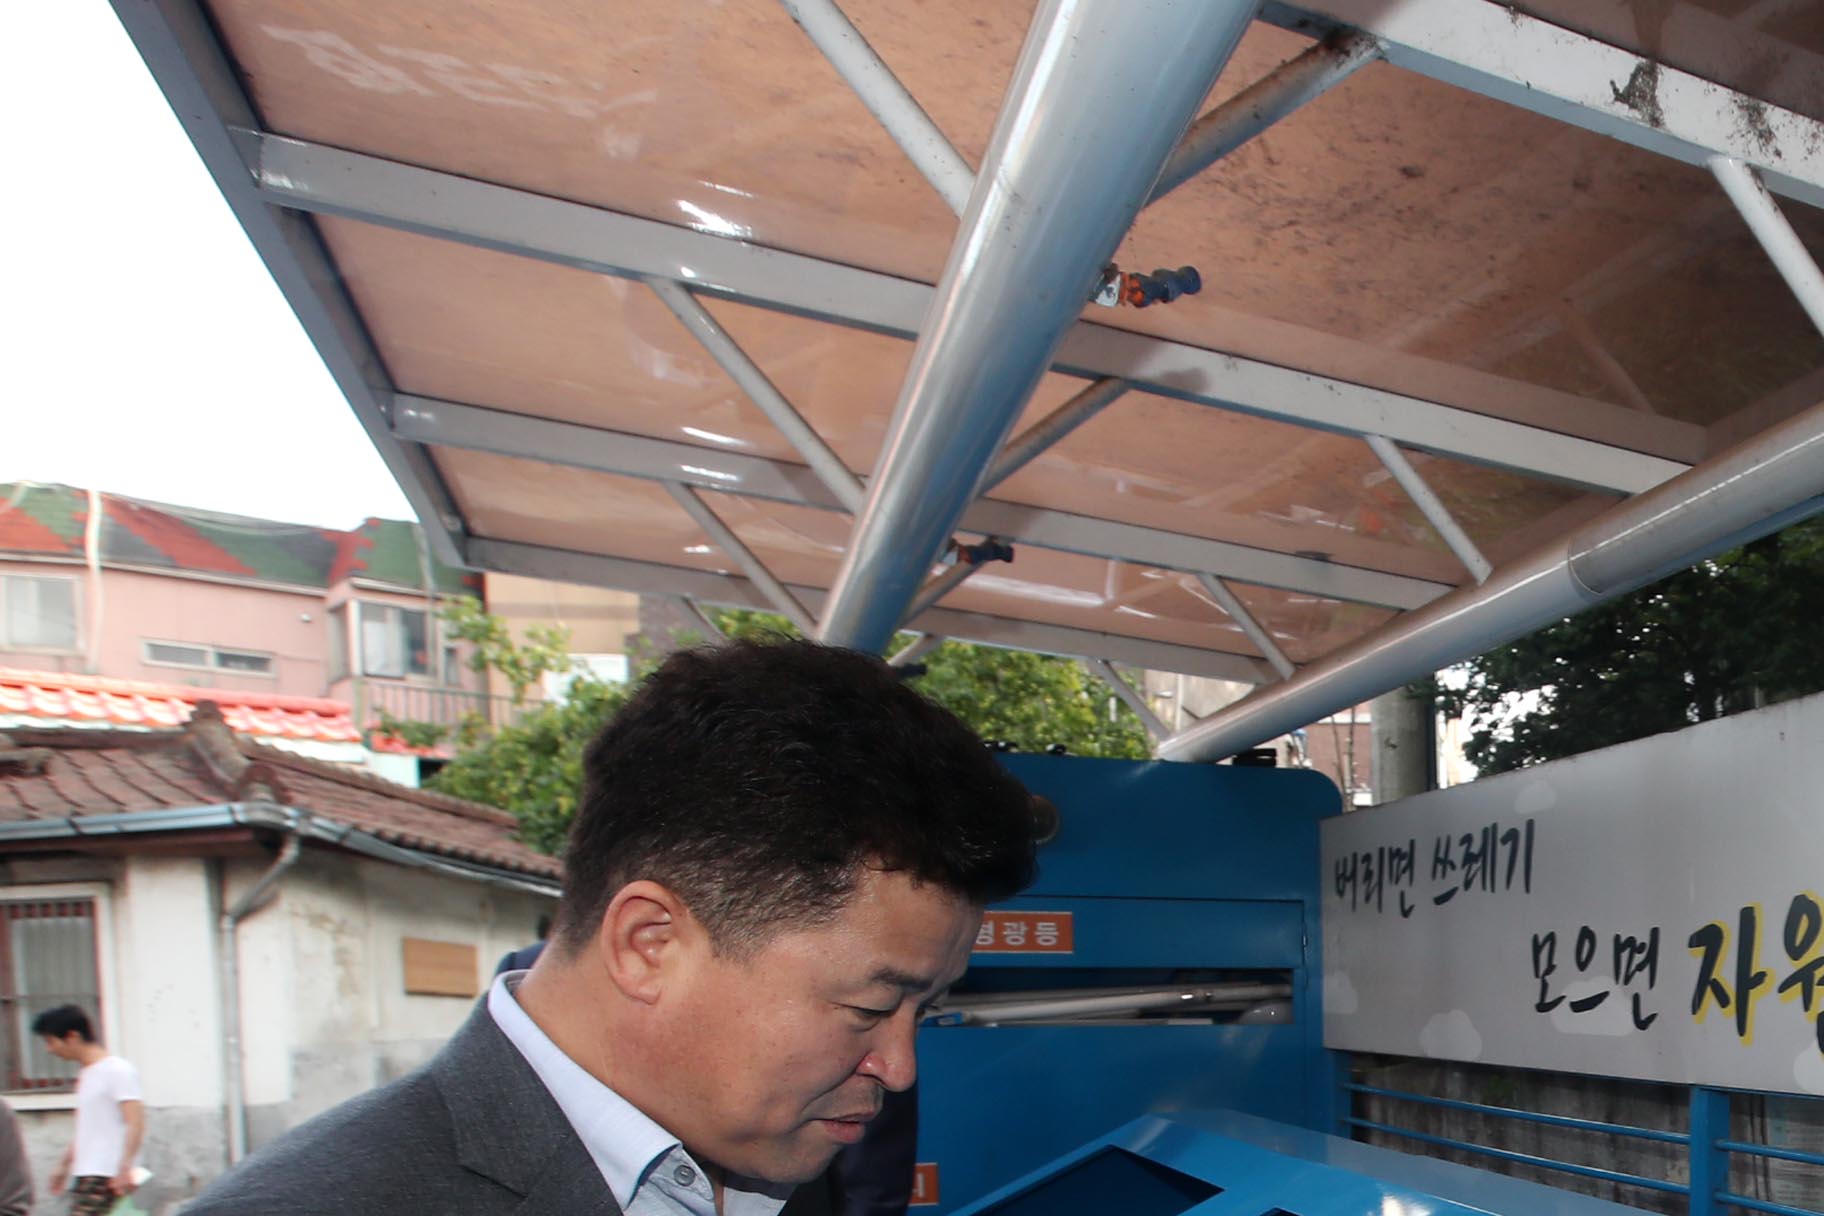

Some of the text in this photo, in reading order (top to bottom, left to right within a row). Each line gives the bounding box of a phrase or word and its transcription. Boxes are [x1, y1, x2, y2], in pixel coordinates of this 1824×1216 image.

[1335, 819, 1534, 918] 버리면 쓰레기
[1531, 926, 1660, 1031] 모으면
